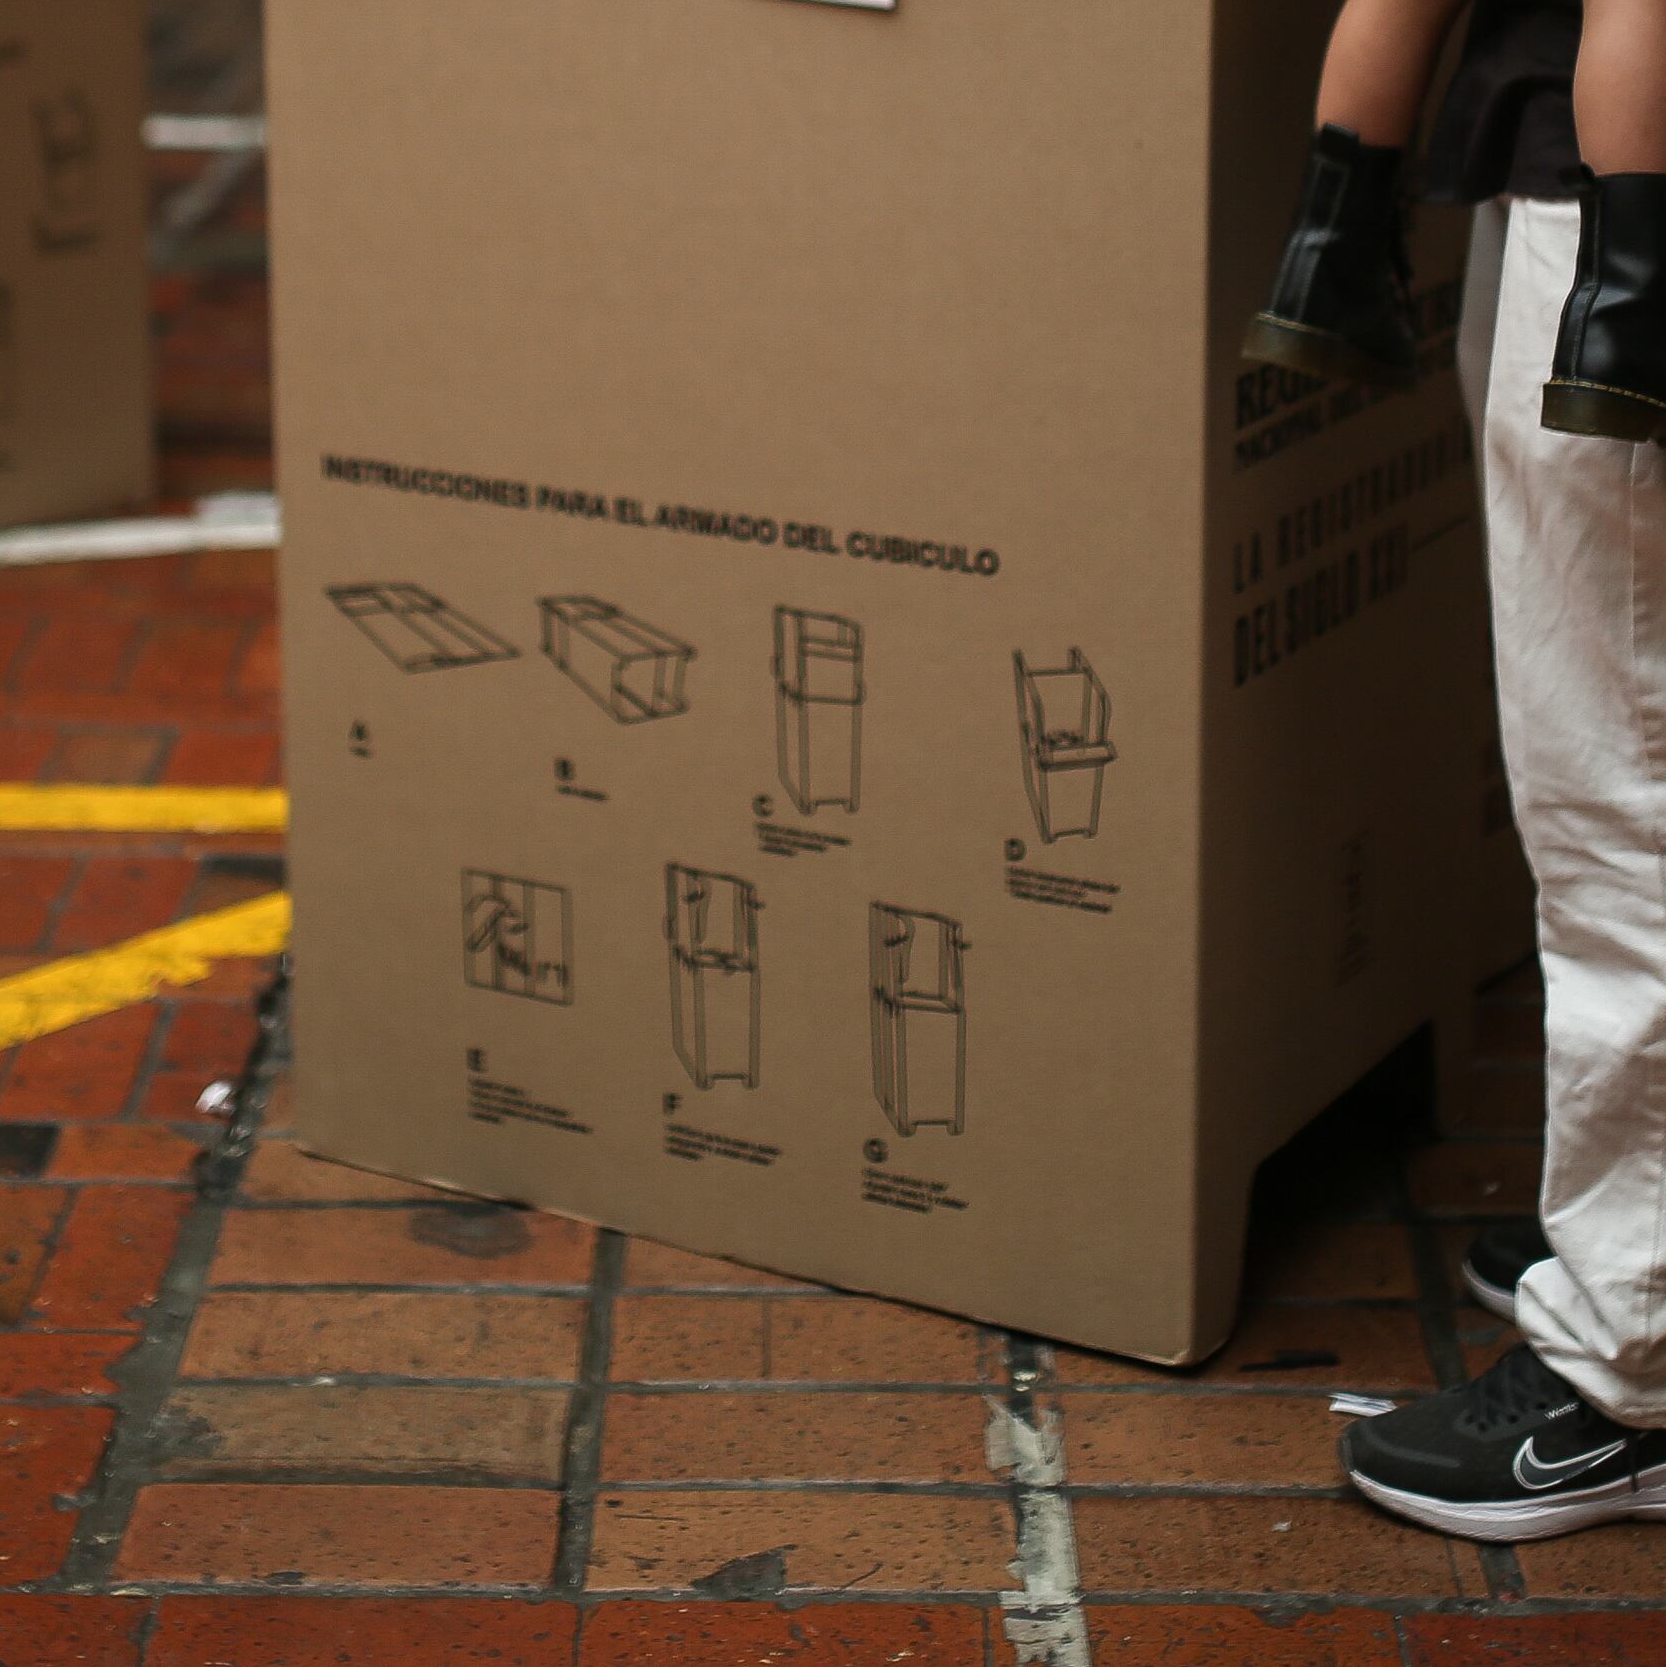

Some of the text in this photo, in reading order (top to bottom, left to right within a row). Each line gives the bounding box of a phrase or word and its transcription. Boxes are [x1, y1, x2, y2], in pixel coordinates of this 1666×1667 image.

[320, 452, 1001, 577] INSTRUCCIONES PARA EL ARMADO DEL CUBICULO
[1232, 532, 1264, 595] LA
[1232, 596, 1282, 689] DEL
[752, 793, 774, 818] C
[1004, 837, 1027, 863] D
[663, 1091, 683, 1116] F
[863, 1137, 889, 1164] G
